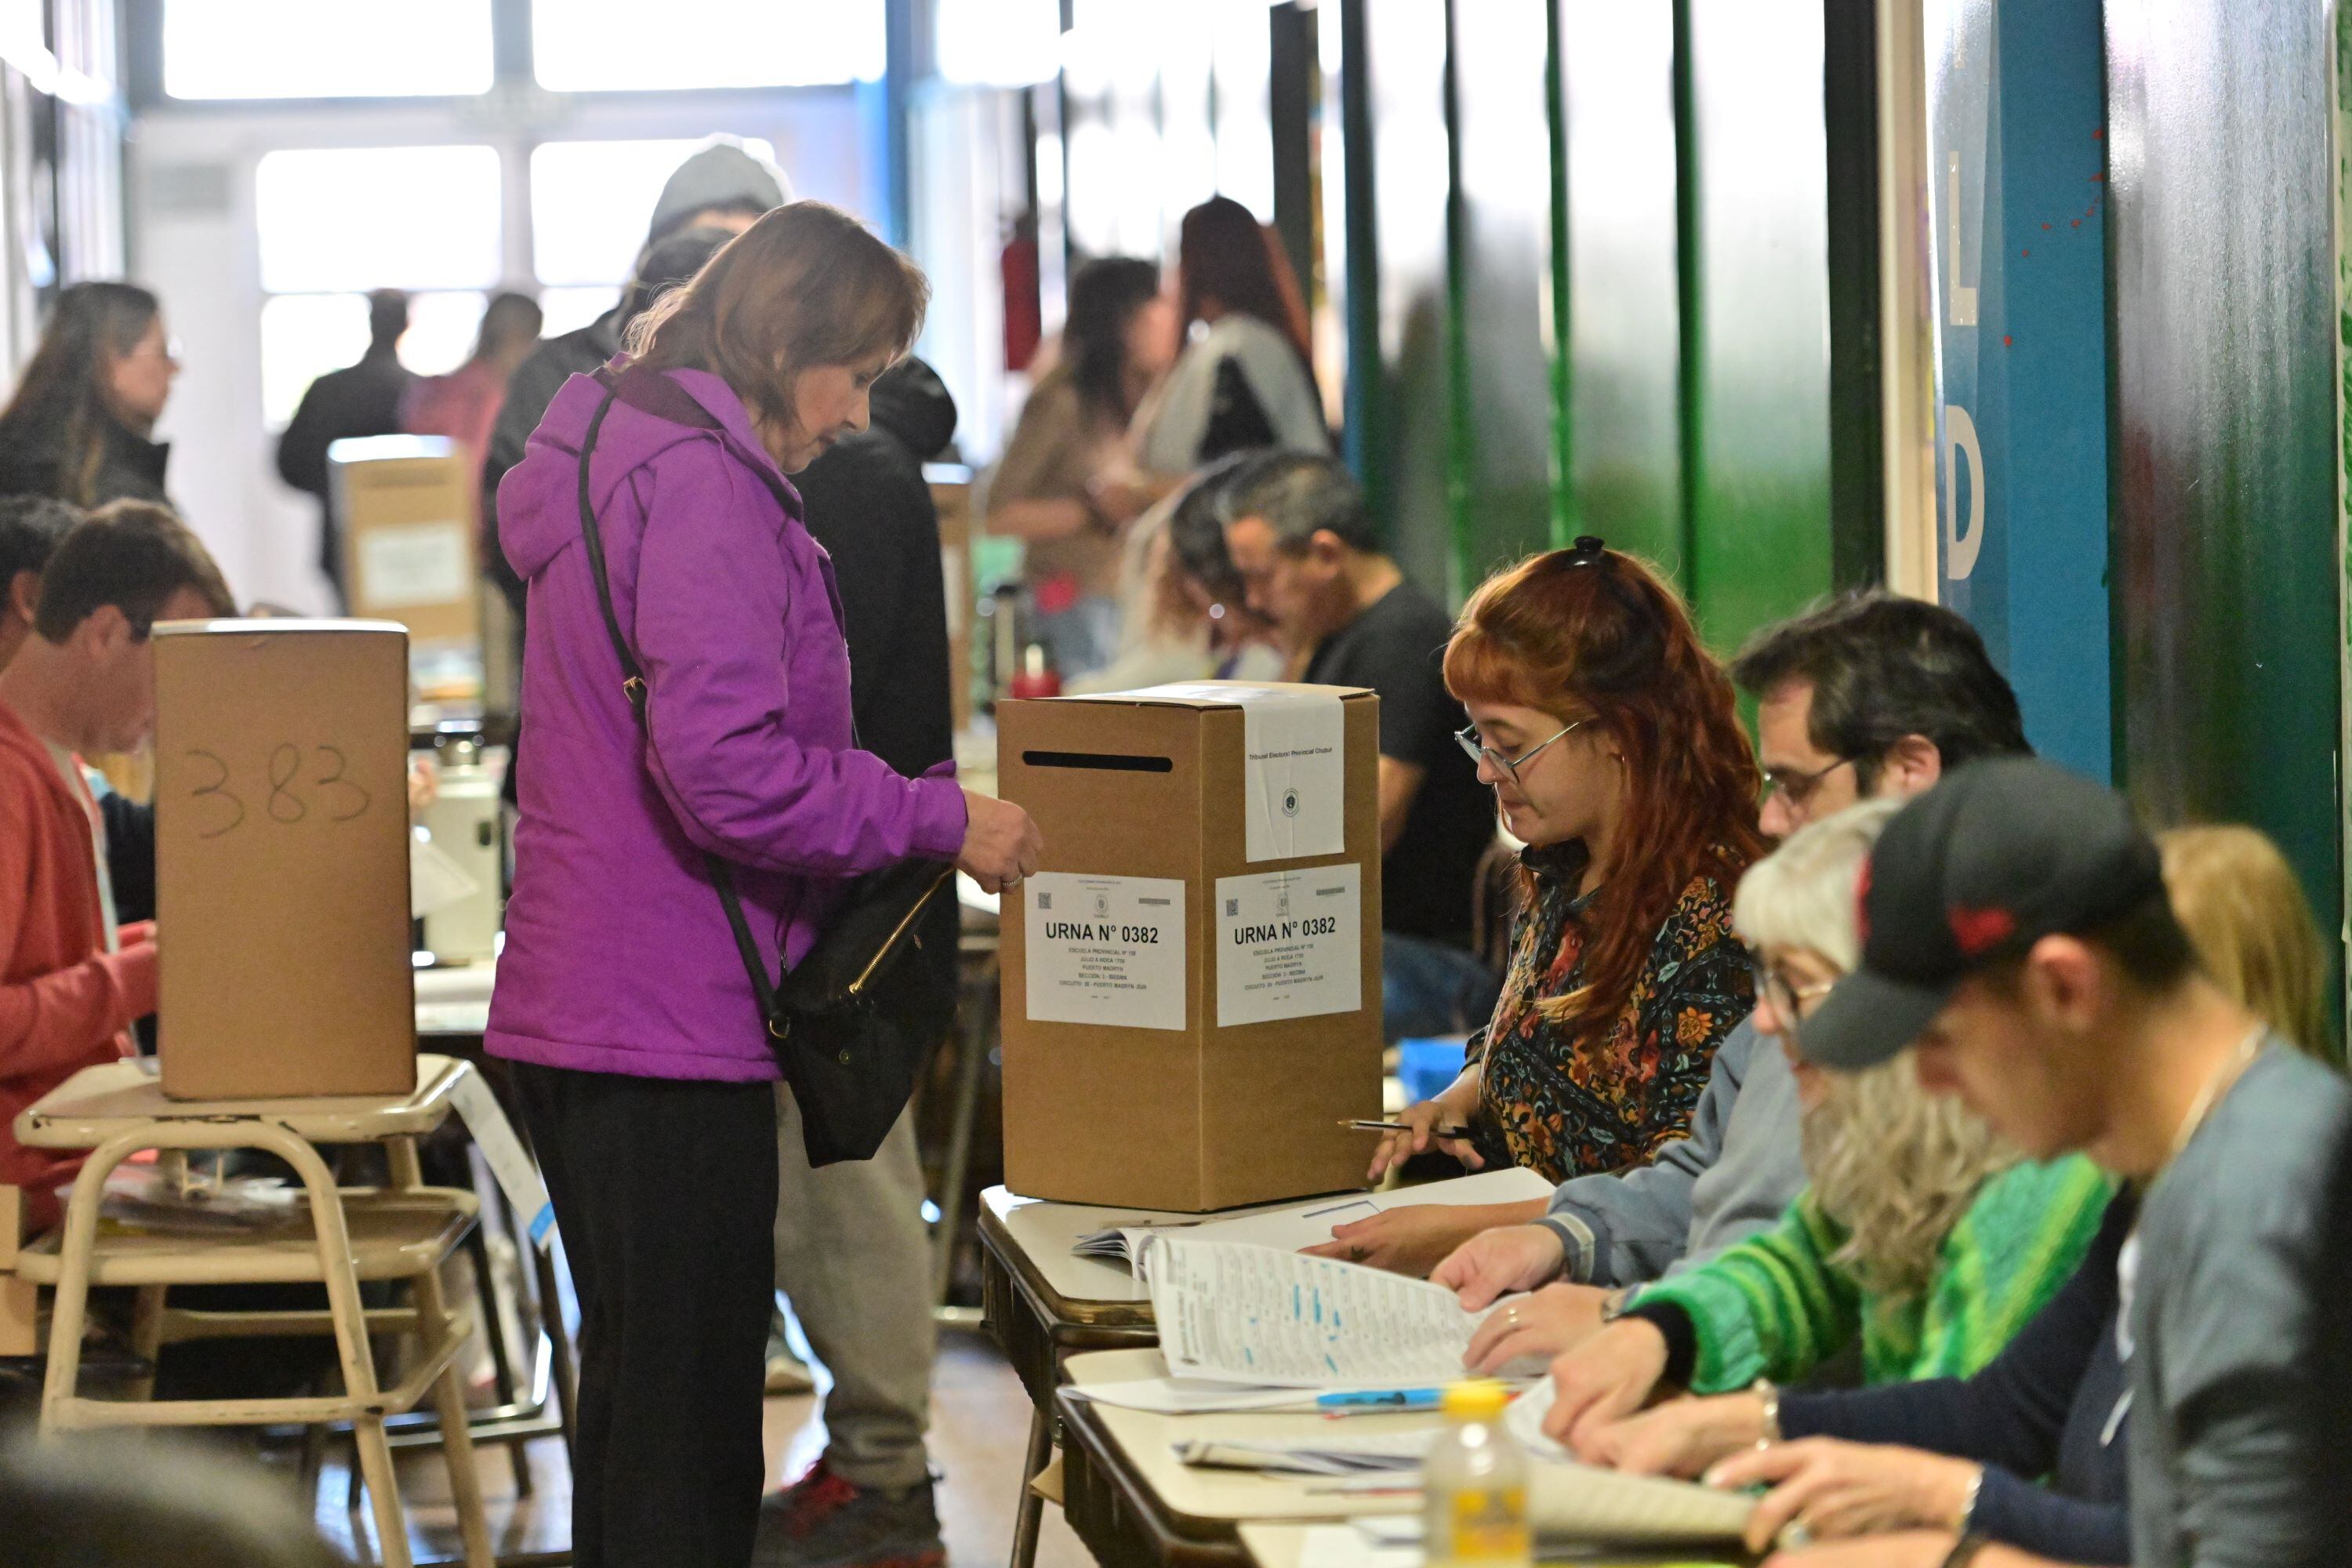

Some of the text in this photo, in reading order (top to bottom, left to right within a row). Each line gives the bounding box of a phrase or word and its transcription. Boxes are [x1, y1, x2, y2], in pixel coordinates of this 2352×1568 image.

[187, 742, 371, 839] 383
[1046, 922, 1158, 943] URNA N° 0382
[1235, 916, 1335, 945] URNA N° 0382
